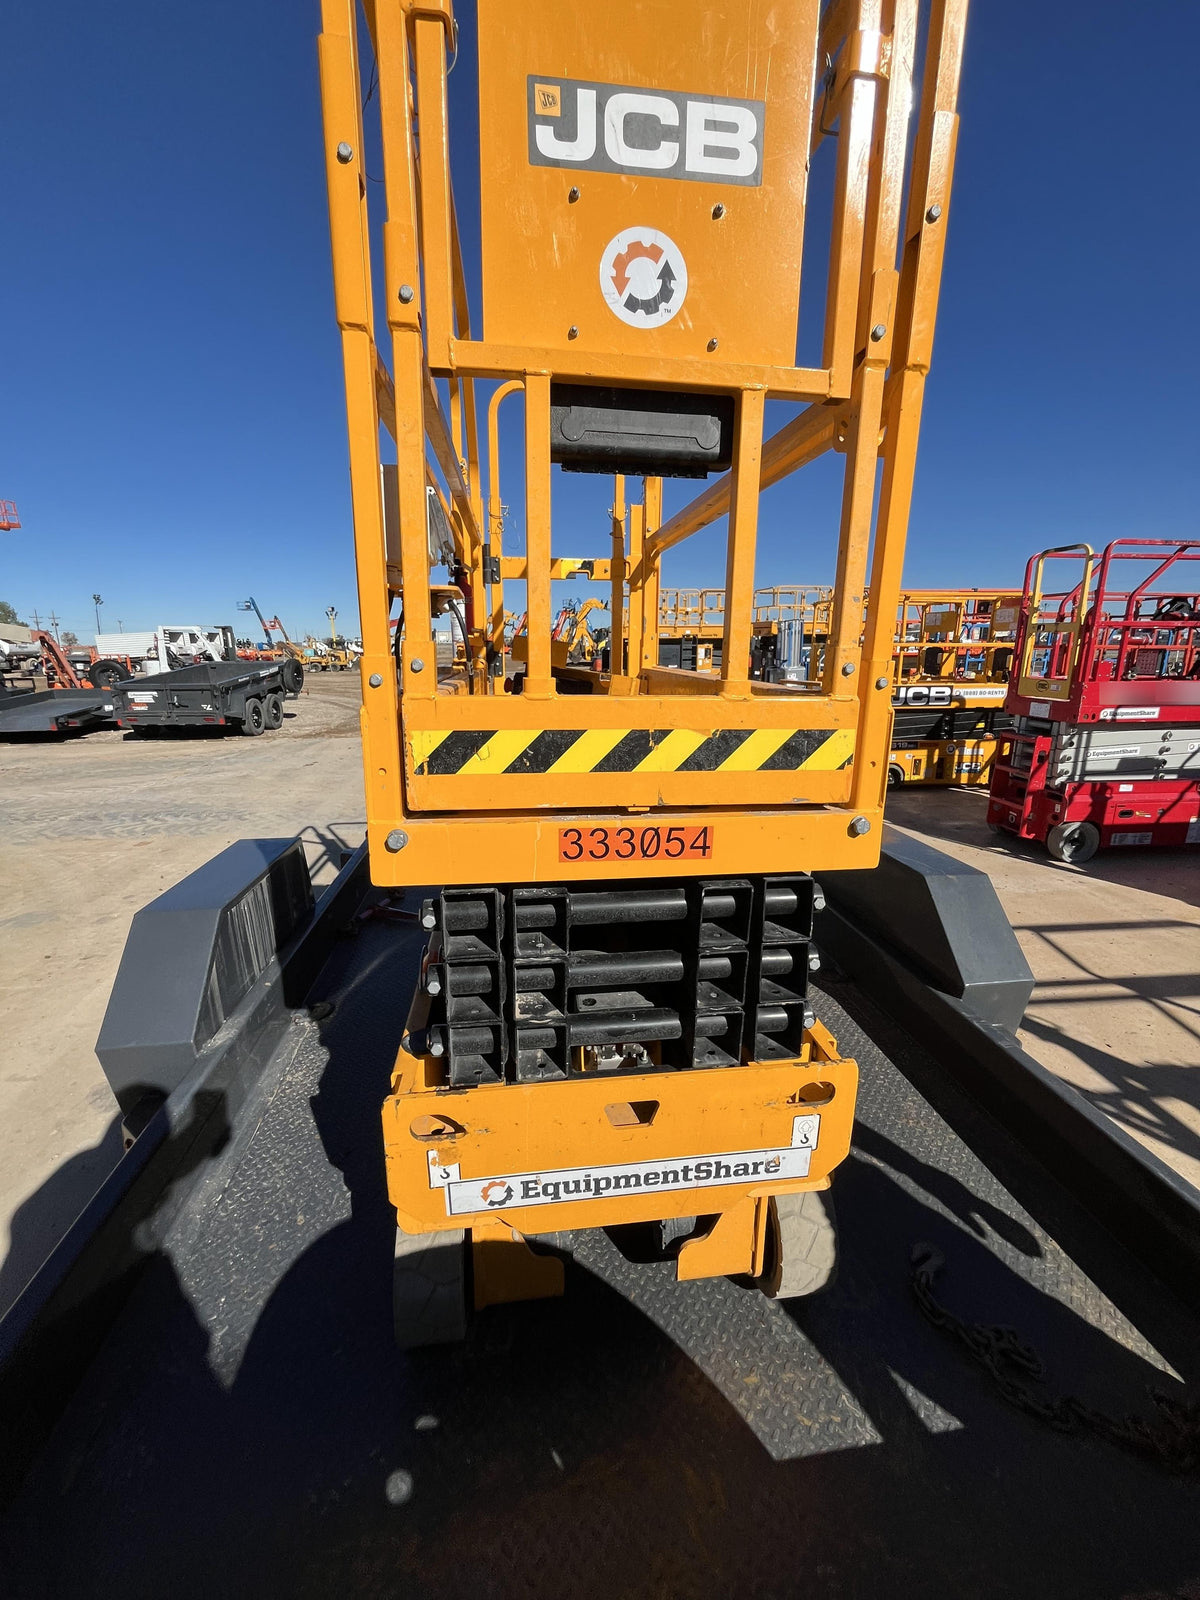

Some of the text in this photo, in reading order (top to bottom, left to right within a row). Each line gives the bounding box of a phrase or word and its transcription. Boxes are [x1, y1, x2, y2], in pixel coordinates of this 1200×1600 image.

[541, 92, 558, 108] JCB
[535, 88, 758, 177] JCB
[891, 686, 952, 706] JCB
[562, 826, 711, 860] 333054
[520, 1158, 781, 1201] EquipmentShare
